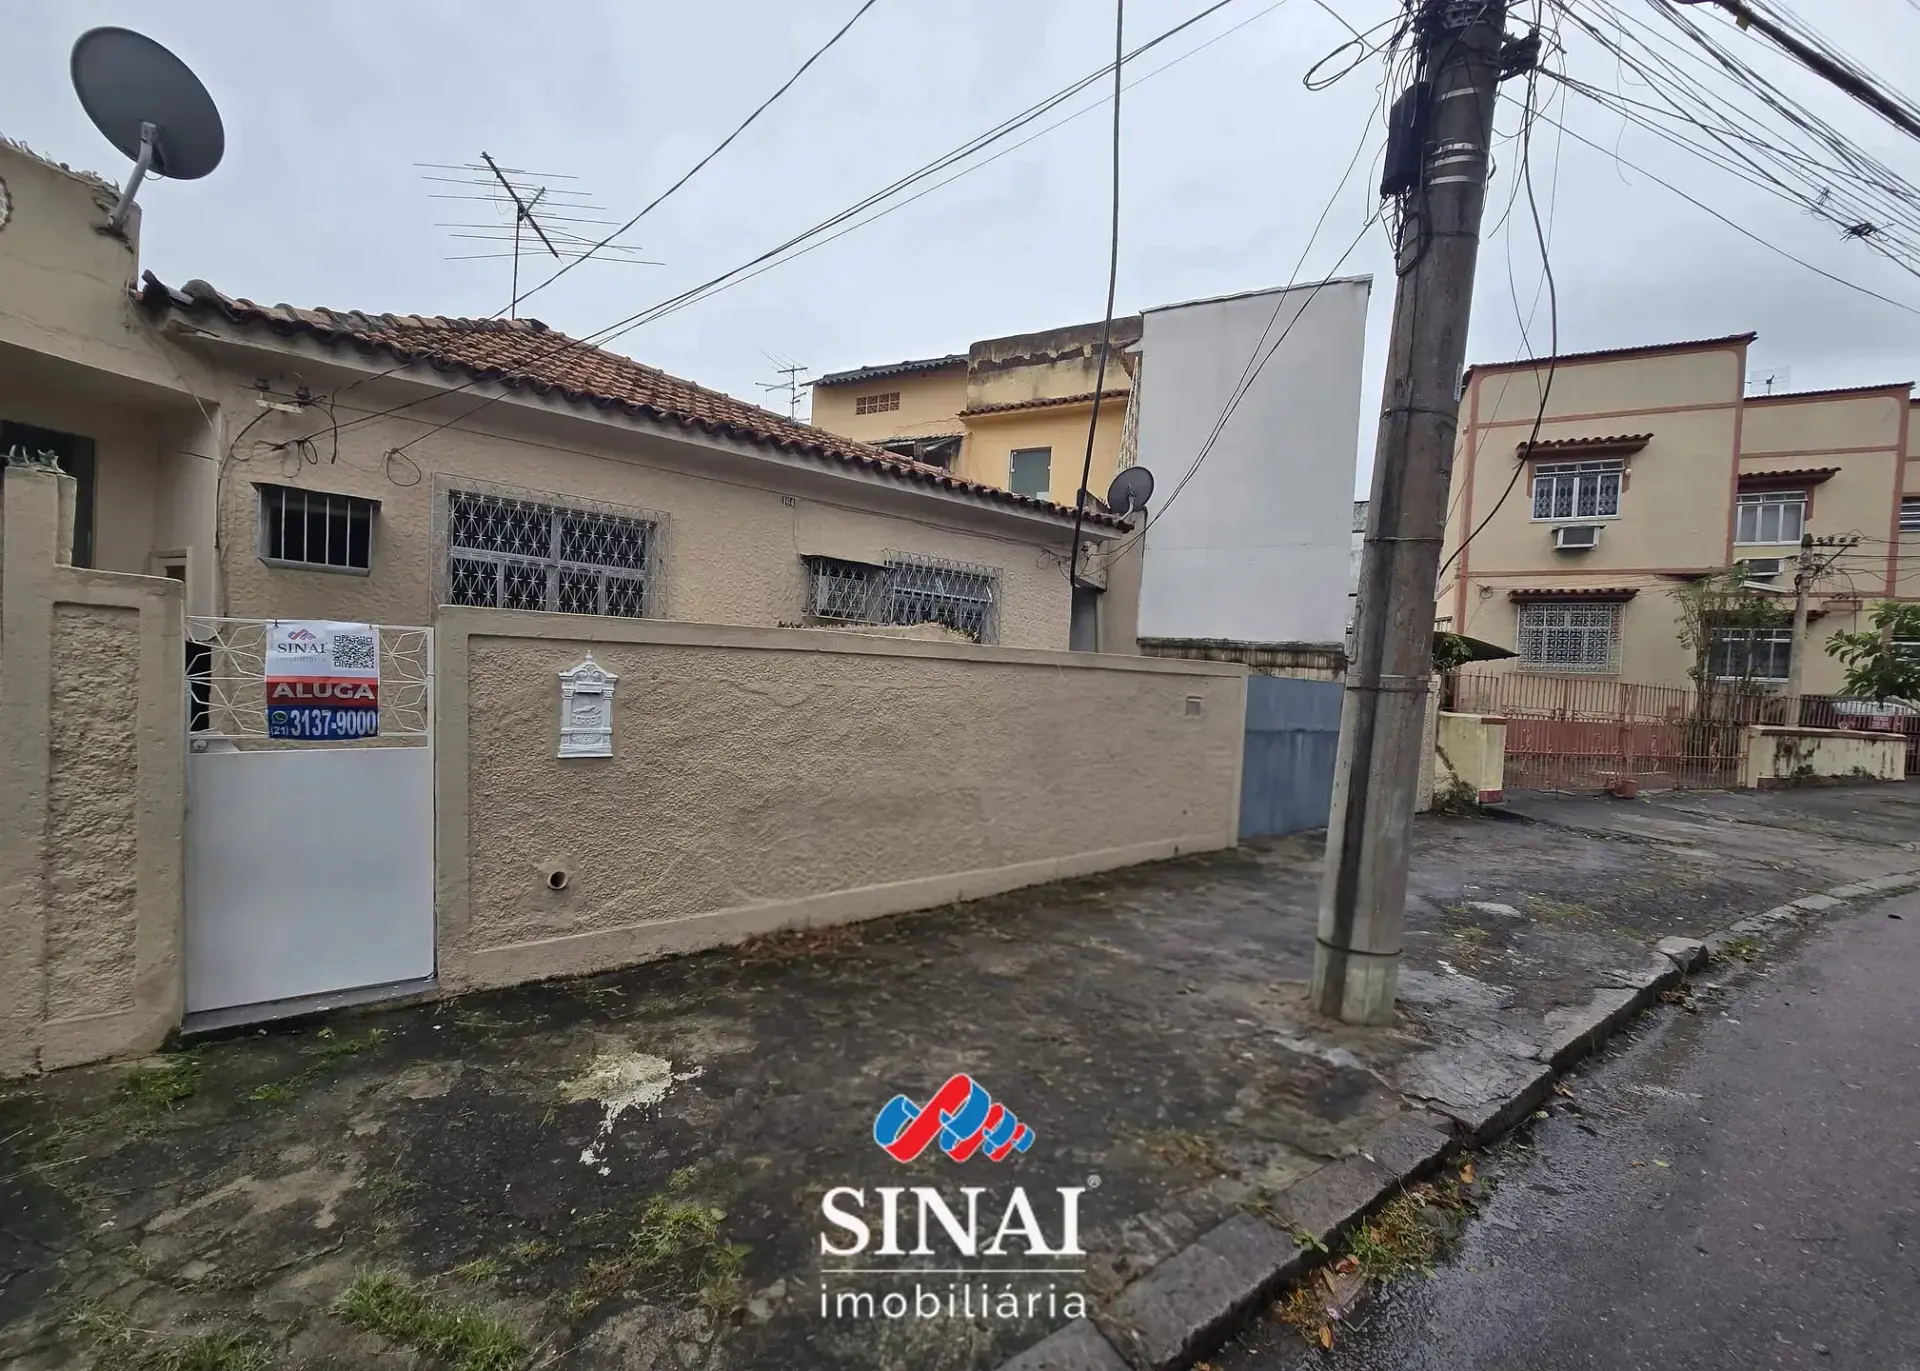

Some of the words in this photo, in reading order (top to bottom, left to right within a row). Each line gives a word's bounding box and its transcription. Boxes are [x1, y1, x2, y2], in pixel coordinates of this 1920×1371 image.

[277, 643, 326, 653] SINAI
[272, 683, 375, 699] ALUGA
[271, 725, 289, 735] (21)
[290, 709, 377, 736] 3137-9000
